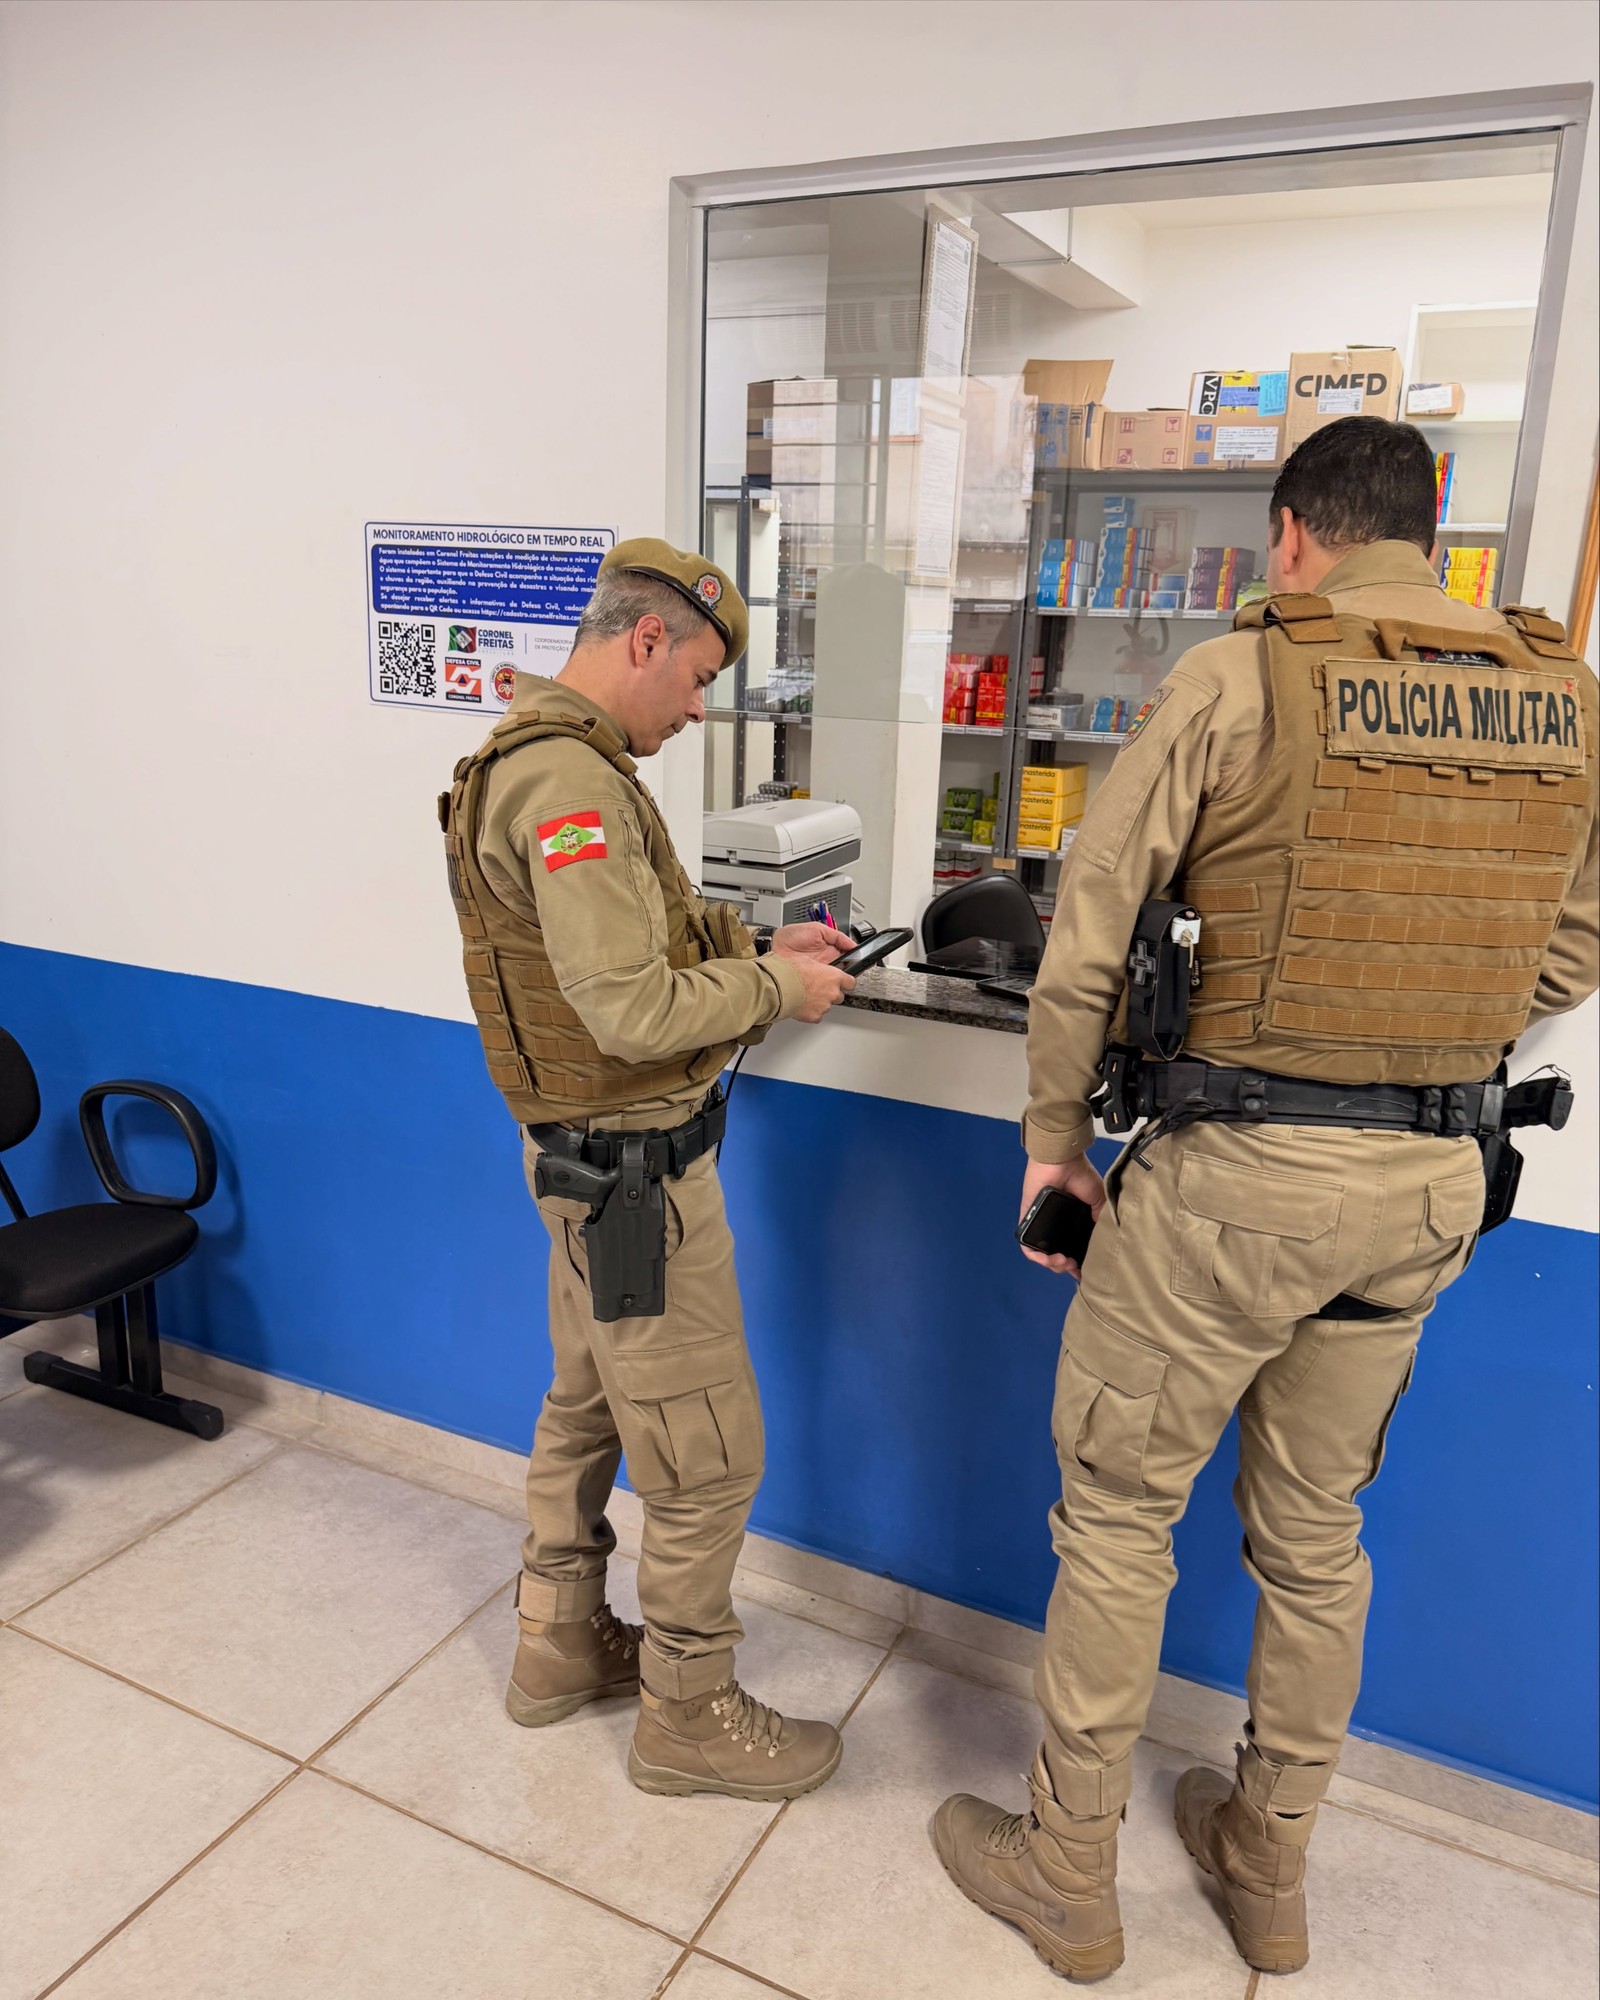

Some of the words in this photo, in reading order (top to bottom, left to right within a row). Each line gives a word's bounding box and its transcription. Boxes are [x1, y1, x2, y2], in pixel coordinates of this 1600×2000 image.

[1295, 373, 1387, 397] CIMED
[373, 529, 454, 541] MONITORAMENTO
[457, 530, 525, 544] HIDROLÓGICO
[527, 535, 541, 545] EM
[543, 535, 578, 546] TEMPO
[580, 536, 605, 547] REAL
[397, 548, 425, 556] instaladas
[436, 549, 458, 557] Coronel
[459, 550, 479, 558] Freitas
[480, 551, 504, 561] estações
[505, 552, 513, 560] de
[514, 553, 539, 562] medição
[550, 554, 568, 562] chuva
[574, 555, 589, 563] nível
[591, 556, 599, 564] de
[379, 557, 393, 566] água
[405, 558, 431, 567] compõem
[437, 559, 458, 567] Sistema
[467, 560, 511, 569] Monitoramento
[511, 562, 545, 572] Hidrológico
[555, 564, 586, 574] município.
[411, 567, 441, 576] importante
[474, 570, 494, 578] Defesa
[494, 571, 508, 579] Civil
[509, 574, 542, 582] acompanhe
[549, 575, 574, 583] situação
[575, 575, 586, 583] dos
[380, 585, 407, 593] segurança
[427, 587, 458, 595] população.
[436, 578, 466, 586] auxiliando
[477, 582, 508, 590] prevenção
[519, 582, 546, 590] desastres
[555, 584, 579, 592] visando
[380, 603, 410, 611] apontando
[429, 605, 438, 613] QR
[438, 605, 453, 613] Code
[391, 593, 411, 602] desejar
[439, 596, 459, 604] alertas
[470, 597, 505, 607] informativos
[509, 600, 518, 608] da
[521, 601, 541, 609] Defesa
[545, 602, 560, 611] Civil,
[564, 604, 585, 612] cadast
[478, 629, 514, 639] CORONEL
[478, 638, 514, 649] FREITAS
[1338, 670, 1462, 738] POLÍCIA
[1468, 686, 1579, 748] MILITAR
[1023, 769, 1055, 777] nasterida
[1019, 823, 1051, 831] nasterida
